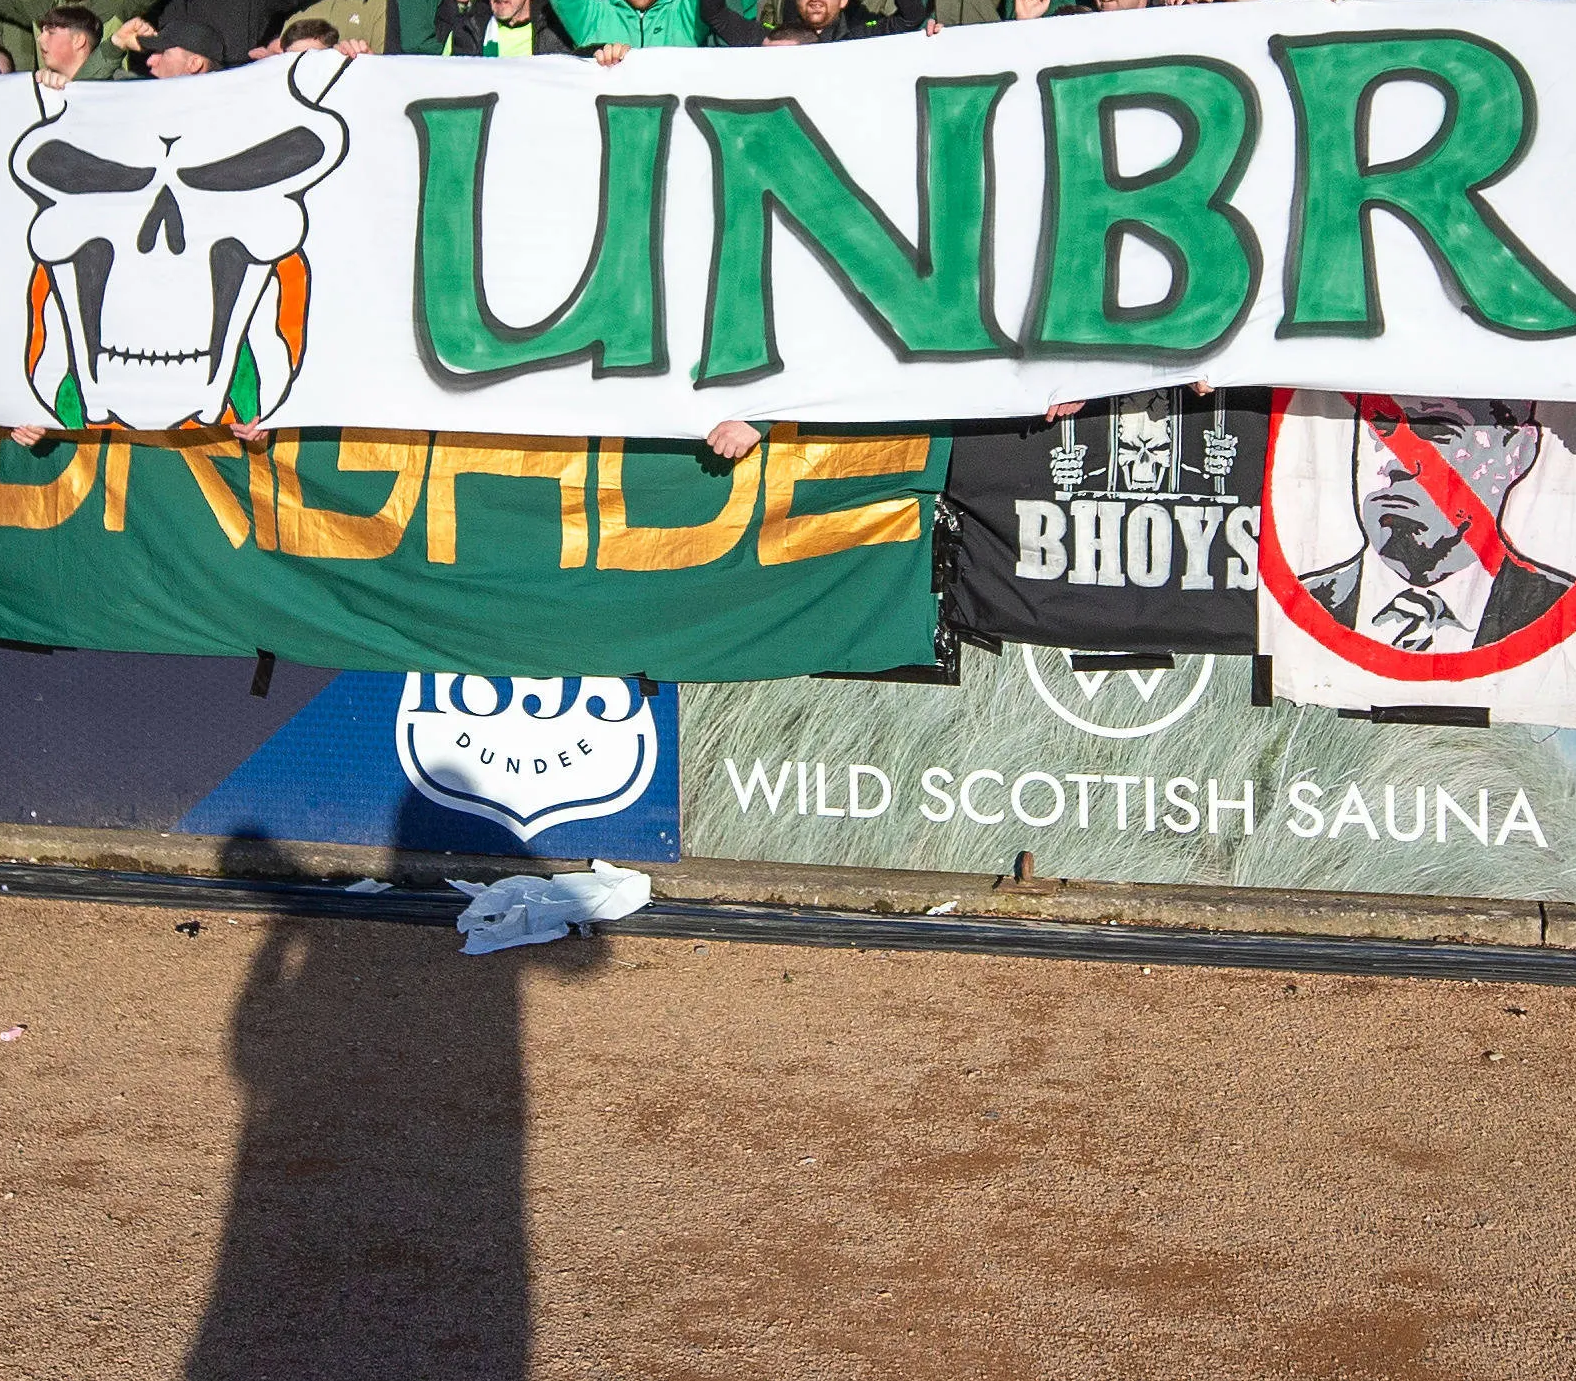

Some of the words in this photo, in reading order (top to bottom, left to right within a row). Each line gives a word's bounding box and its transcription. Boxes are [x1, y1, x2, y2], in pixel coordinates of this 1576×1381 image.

[1015, 499, 1261, 591] BHOYS
[456, 731, 593, 774] DUNDEE
[724, 757, 892, 818] WILD
[920, 767, 1254, 836] SCOTTISH
[1287, 780, 1548, 849] SAUNA
